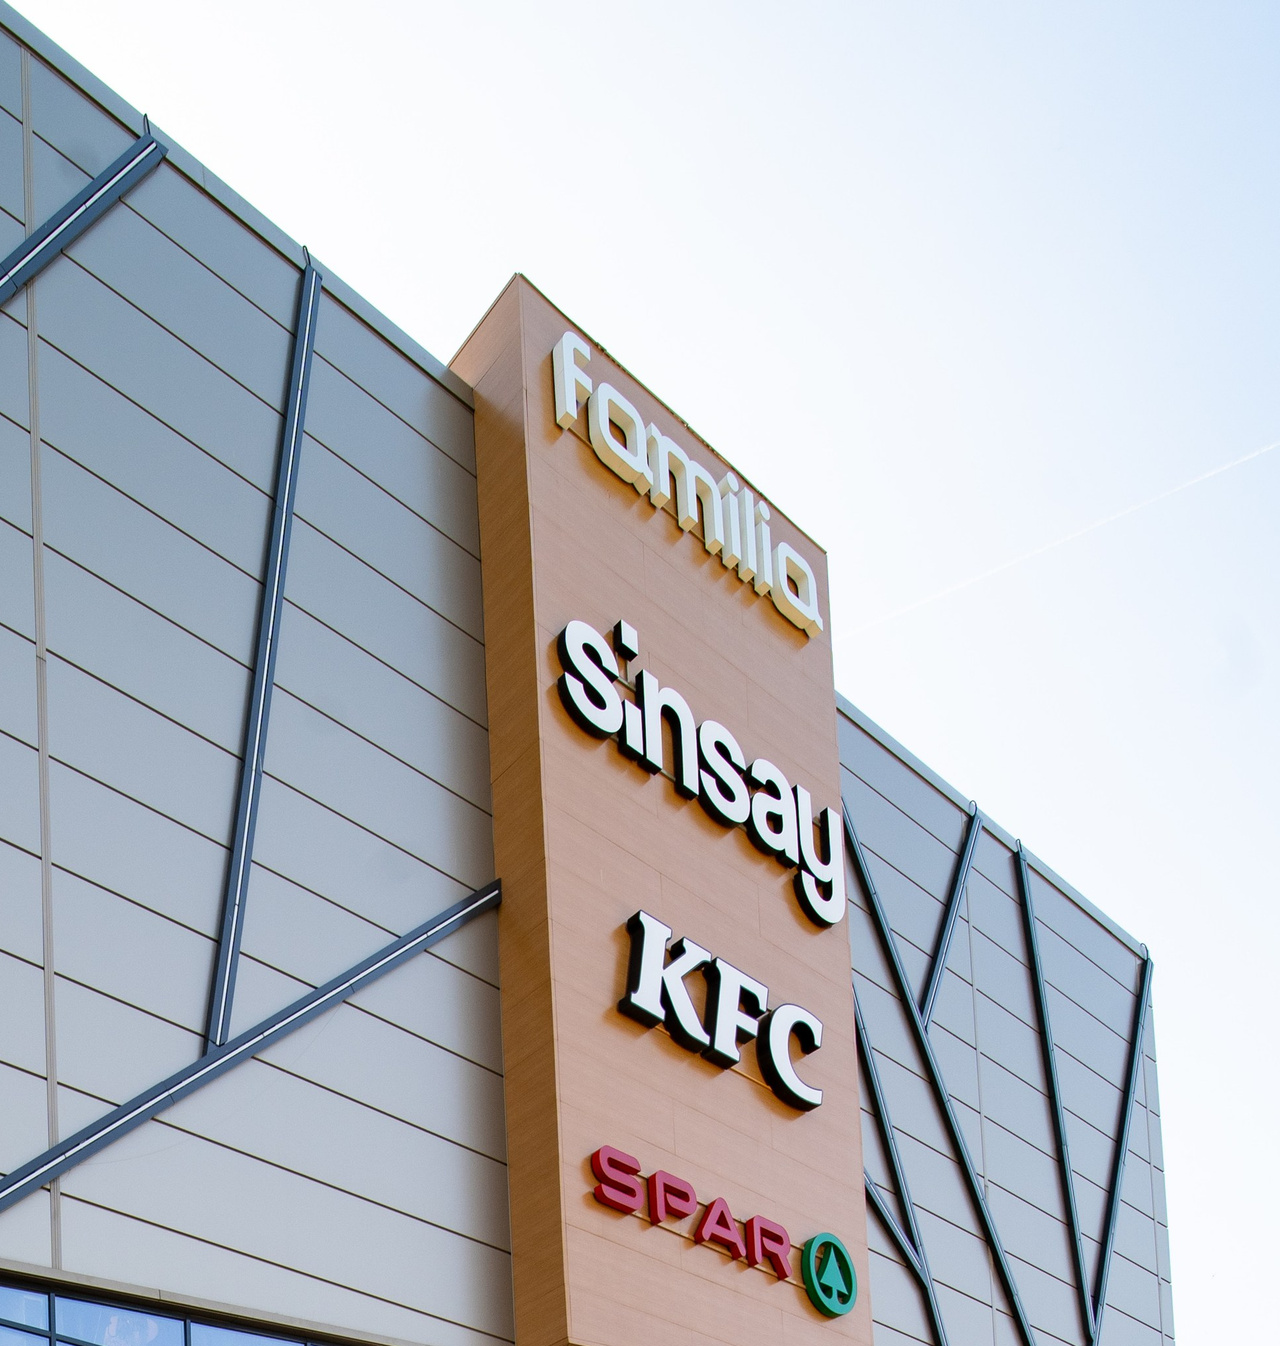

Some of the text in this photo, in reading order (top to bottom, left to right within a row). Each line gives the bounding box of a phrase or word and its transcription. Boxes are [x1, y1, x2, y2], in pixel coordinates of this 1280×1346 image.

[552, 331, 823, 640] familia
[618, 909, 823, 1111] KFC
[591, 1145, 793, 1280] SPAR
